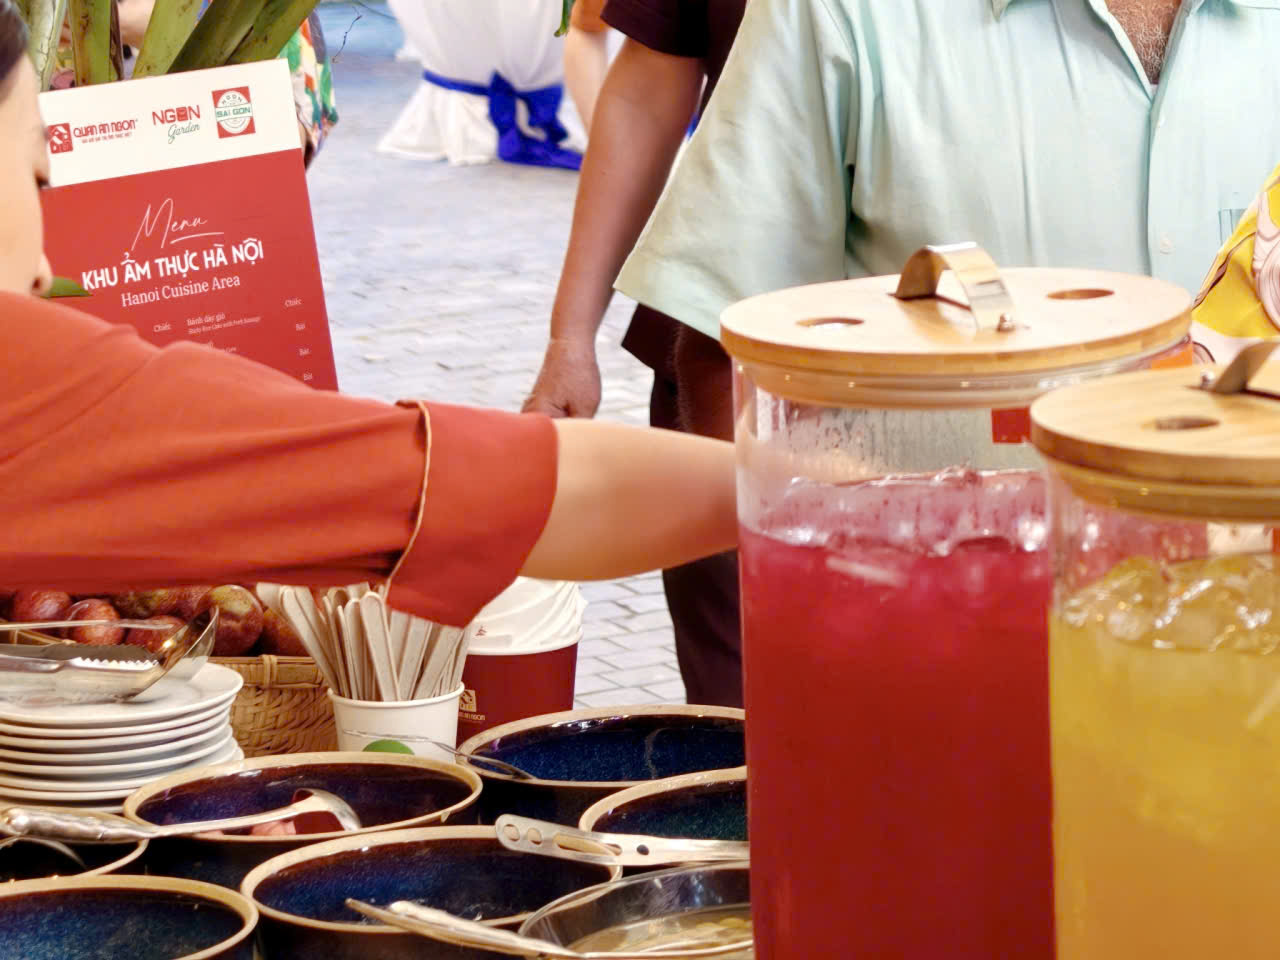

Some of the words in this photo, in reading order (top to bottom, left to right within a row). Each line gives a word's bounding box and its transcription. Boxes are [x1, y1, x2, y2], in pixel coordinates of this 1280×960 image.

[168, 121, 200, 144] Garden
[131, 198, 208, 251] Menu
[81, 266, 118, 291] KHU
[120, 252, 152, 284] ẨM
[154, 249, 200, 278] THỰC
[203, 243, 228, 269] HÀ
[231, 238, 265, 266] NỘI
[121, 289, 160, 307] Hanoi
[161, 278, 209, 300] Cuisine
[212, 275, 241, 290] Area
